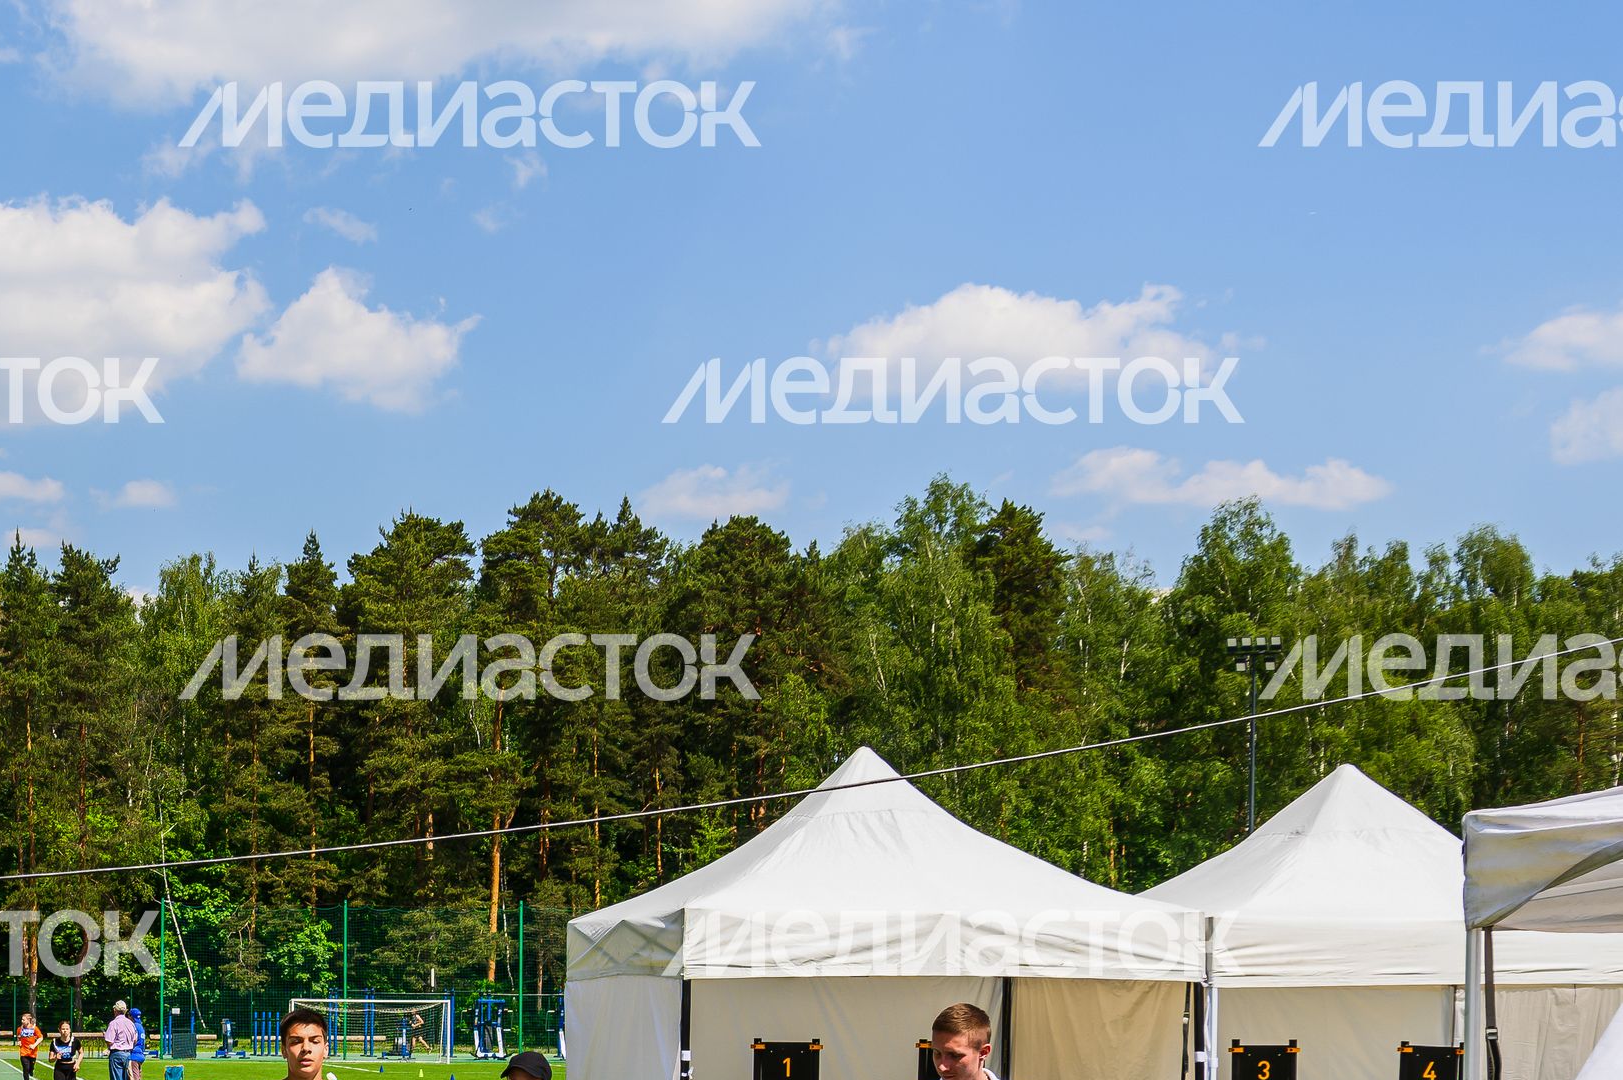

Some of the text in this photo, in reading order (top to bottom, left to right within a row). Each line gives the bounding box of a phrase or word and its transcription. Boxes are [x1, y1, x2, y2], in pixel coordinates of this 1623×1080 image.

[782, 1057, 792, 1078] 1
[1257, 1060, 1271, 1080] 3
[1422, 1061, 1438, 1080] 4
